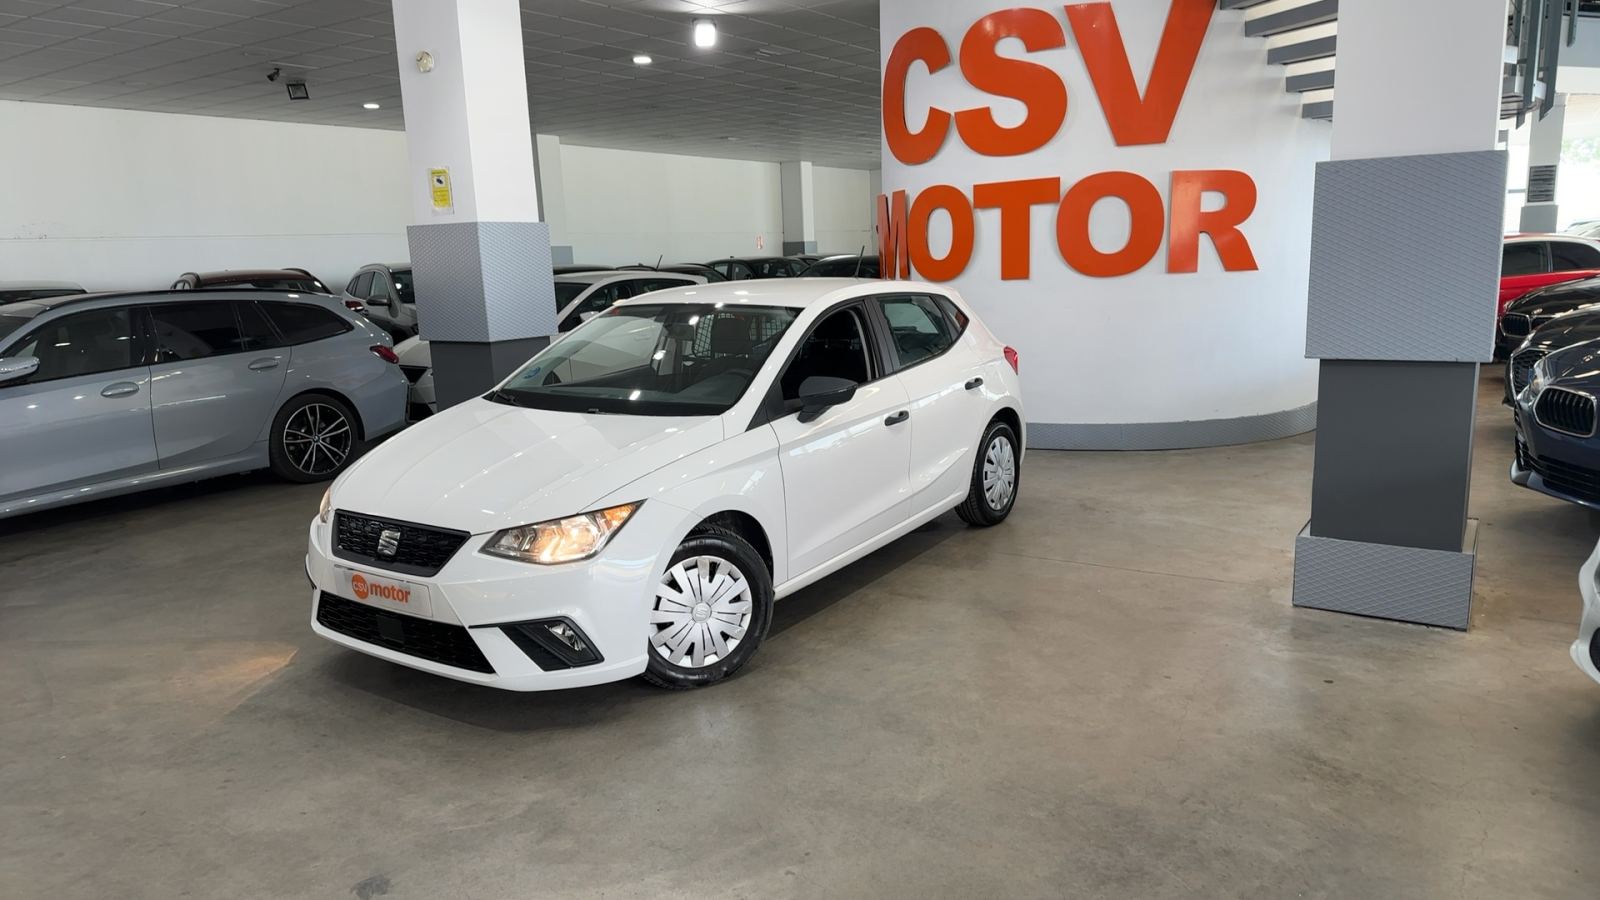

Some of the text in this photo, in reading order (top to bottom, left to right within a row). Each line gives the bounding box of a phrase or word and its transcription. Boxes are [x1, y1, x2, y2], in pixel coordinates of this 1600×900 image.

[882, 0, 1216, 165] CSV
[877, 170, 1258, 282] MOTOR
[370, 583, 411, 603] motor
